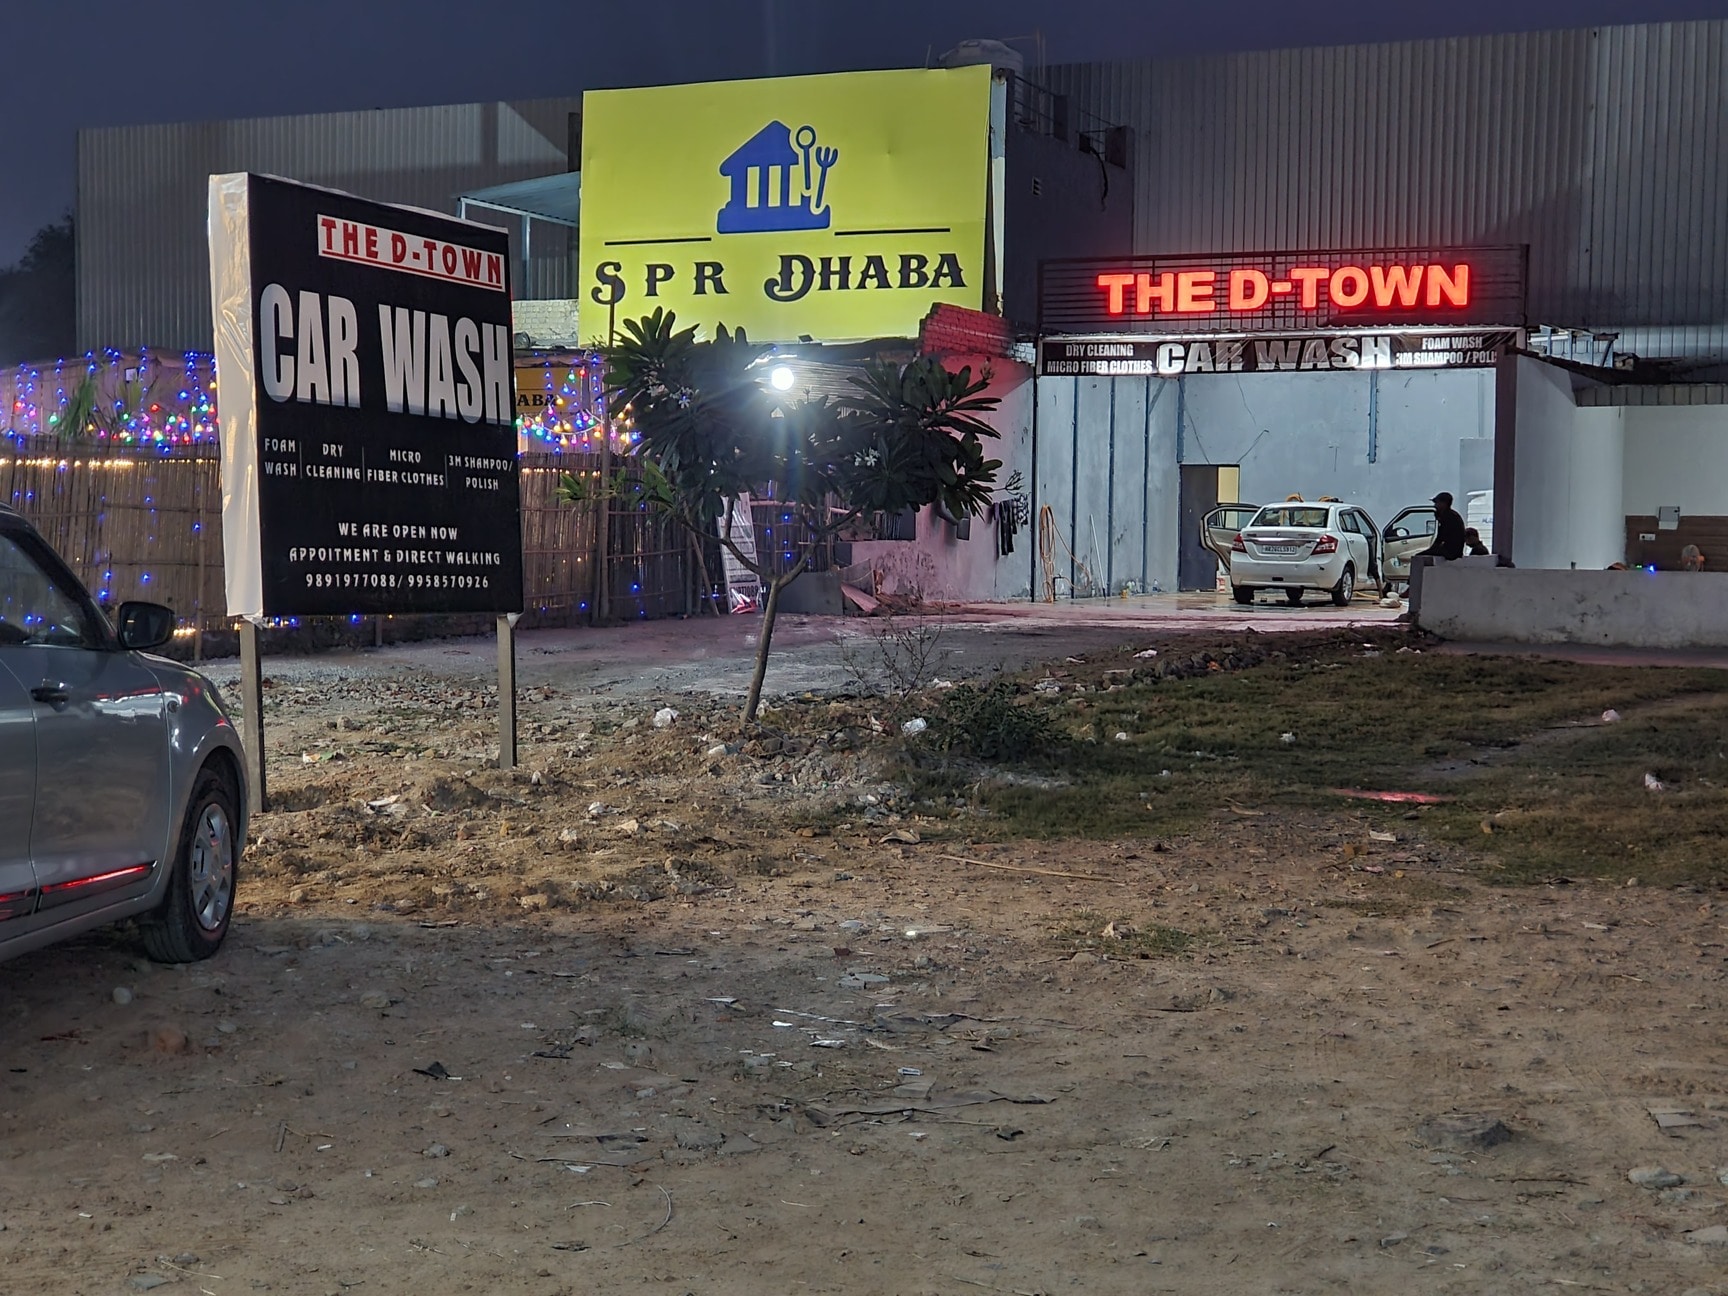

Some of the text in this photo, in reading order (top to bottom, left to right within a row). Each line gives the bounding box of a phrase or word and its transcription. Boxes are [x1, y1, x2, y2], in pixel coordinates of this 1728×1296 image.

[321, 217, 501, 285] THE D-TOWN
[763, 252, 968, 302] DHABA
[1097, 264, 1470, 314] THE D-TOWN
[1066, 343, 1134, 357] DRY CLEANING
[1422, 336, 1483, 350] FOAM WASH
[260, 283, 512, 426] CAR WASH
[1157, 336, 1391, 375] CAR WASH
[1395, 352, 1413, 365] 3M
[1413, 351, 1463, 365] SHAMPOO
[1047, 360, 1153, 374] MICRO FIBER CLOTHES
[264, 438, 296, 453] FOAM
[322, 443, 344, 457] DRY
[389, 449, 421, 464] MICRO
[449, 454, 462, 467] 3M
[264, 462, 297, 476] WASH
[306, 465, 360, 480] CLEANING
[367, 468, 445, 486] FIBER CLOTHES
[465, 477, 499, 490] POLISH
[338, 522, 457, 541] WE ARE OPEN NOW
[289, 547, 500, 566] APPOITMENT & DIRECT WALKING
[408, 574, 489, 589] 9958570926
